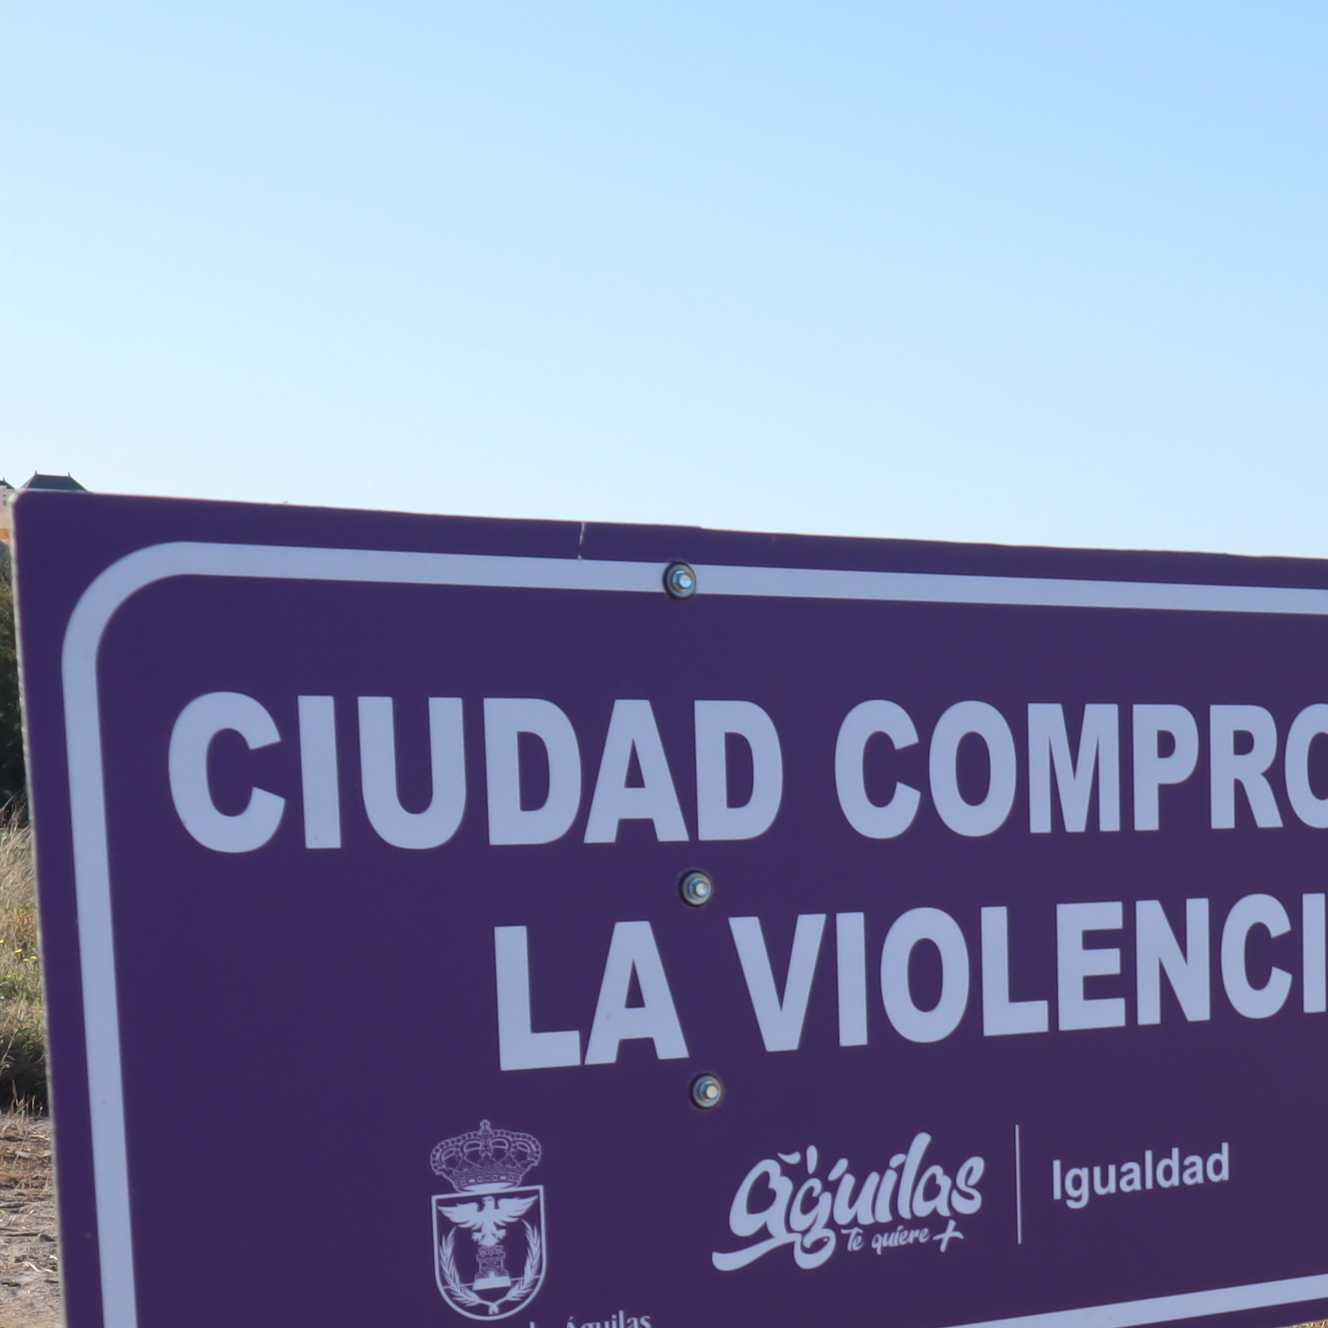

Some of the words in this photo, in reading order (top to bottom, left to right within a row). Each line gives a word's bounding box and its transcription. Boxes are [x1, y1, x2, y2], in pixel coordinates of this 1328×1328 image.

[168, 691, 783, 853] CIUDAD
[494, 920, 690, 1071] LA
[1052, 1142, 1230, 1209] Igualdad
[871, 1225, 930, 1256] quiere
